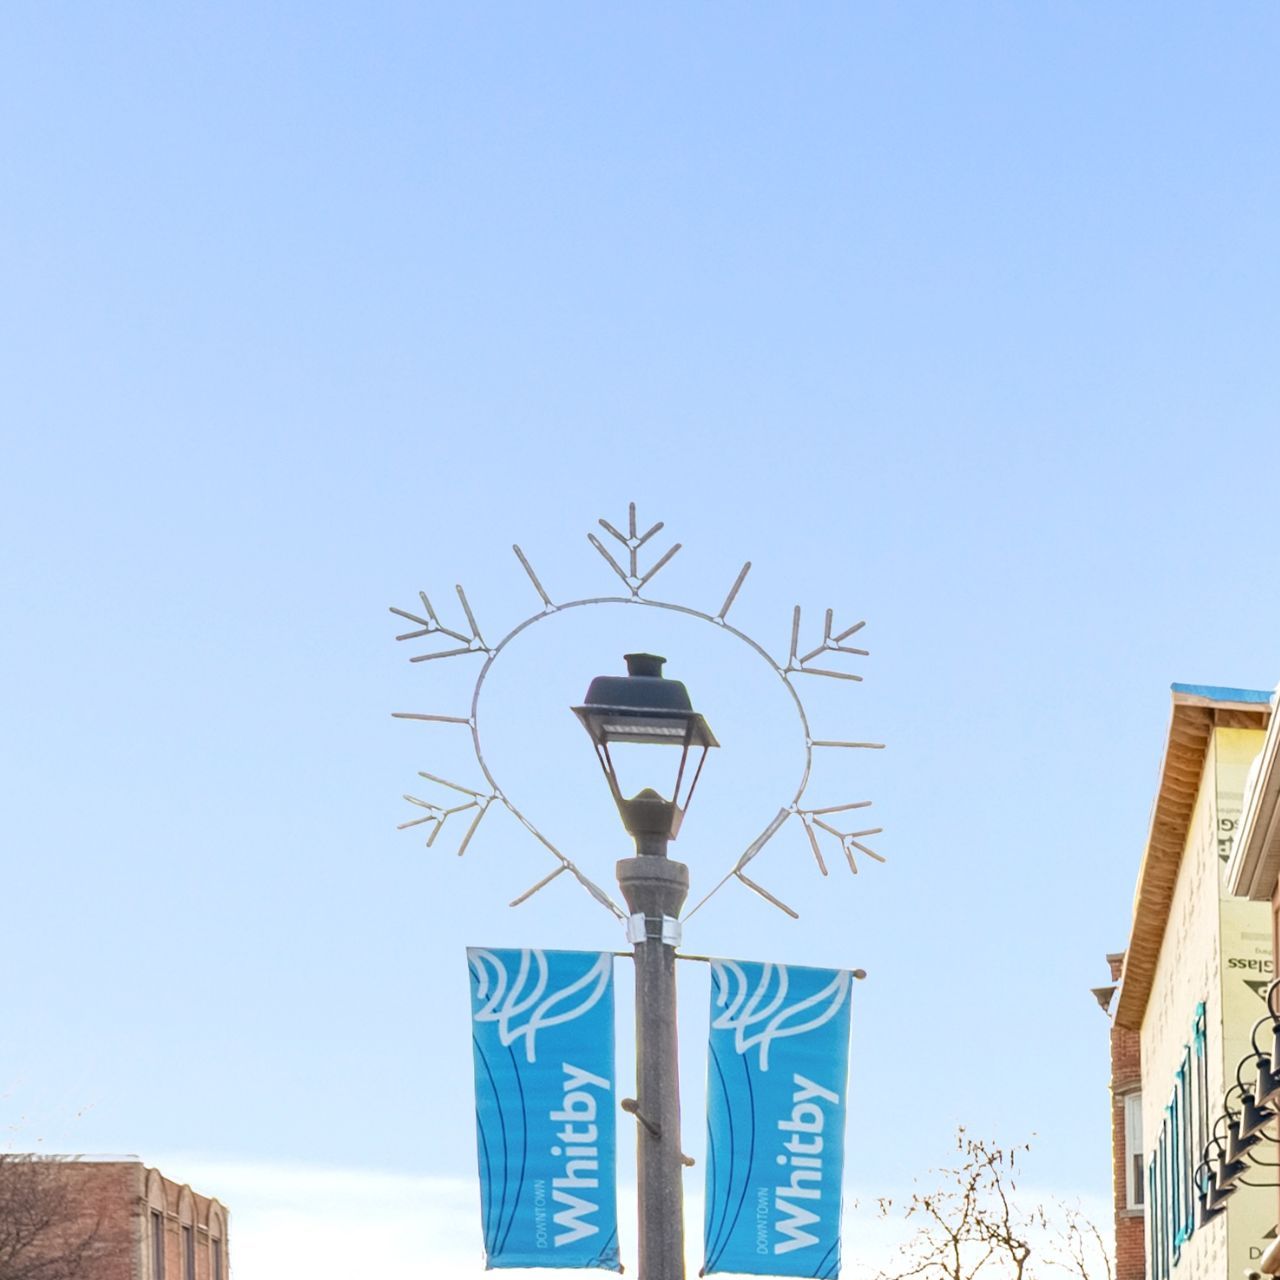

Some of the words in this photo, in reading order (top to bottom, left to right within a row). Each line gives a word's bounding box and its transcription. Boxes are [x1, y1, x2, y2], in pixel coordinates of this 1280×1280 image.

[534, 1179, 548, 1249] DOWNTOWN
[550, 1062, 611, 1248] Whitby
[774, 1073, 839, 1256] Whitby
[756, 1187, 769, 1255] DOWNTOWN
